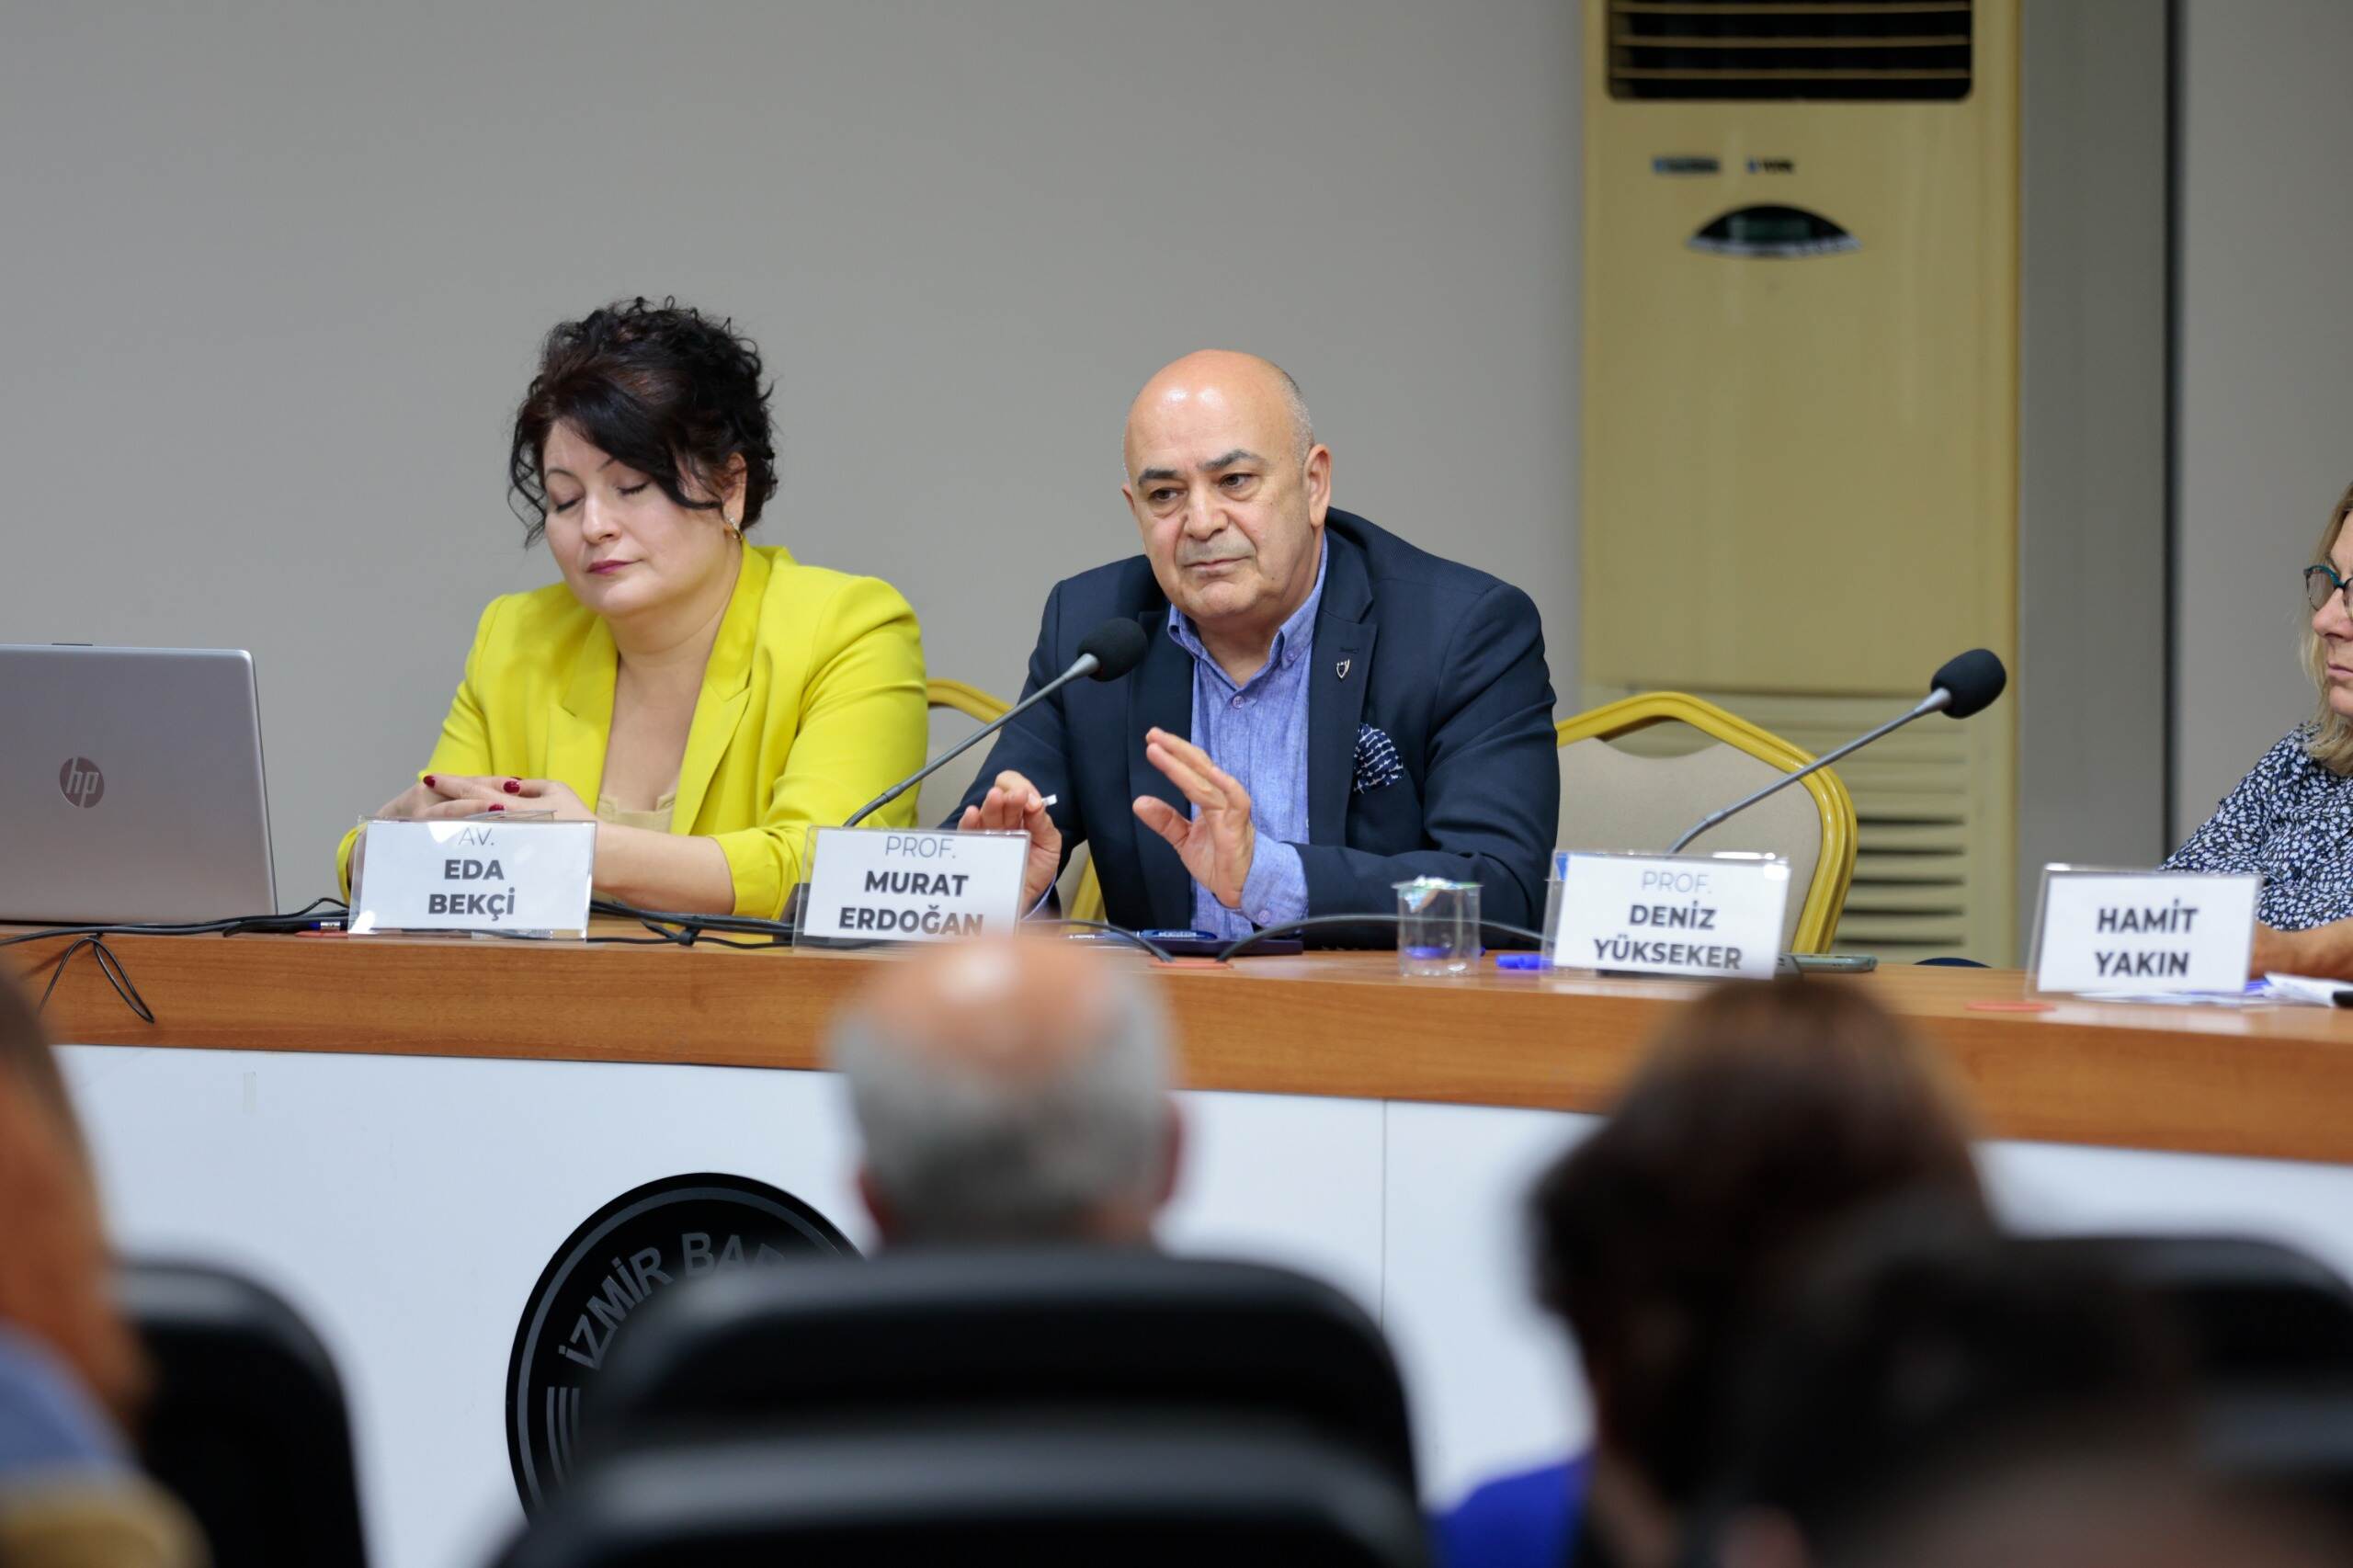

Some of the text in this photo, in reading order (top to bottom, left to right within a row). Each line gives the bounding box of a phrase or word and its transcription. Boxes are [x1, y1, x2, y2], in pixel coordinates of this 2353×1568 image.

[66, 757, 99, 808] hp
[459, 827, 494, 846] AV.
[885, 835, 956, 858] PROF.
[444, 859, 505, 880] EDA
[864, 870, 969, 897] MURAT
[1642, 870, 1712, 894] PROF.
[428, 887, 515, 921] BEKÇİ
[1629, 900, 1717, 930] DENİZ
[2097, 898, 2199, 934] HAMİT
[838, 904, 983, 936] ERDOĞAN
[1593, 934, 1743, 970] YÜKSEKER
[2095, 951, 2189, 977] YAKIN
[558, 1245, 675, 1370] İZMİR
